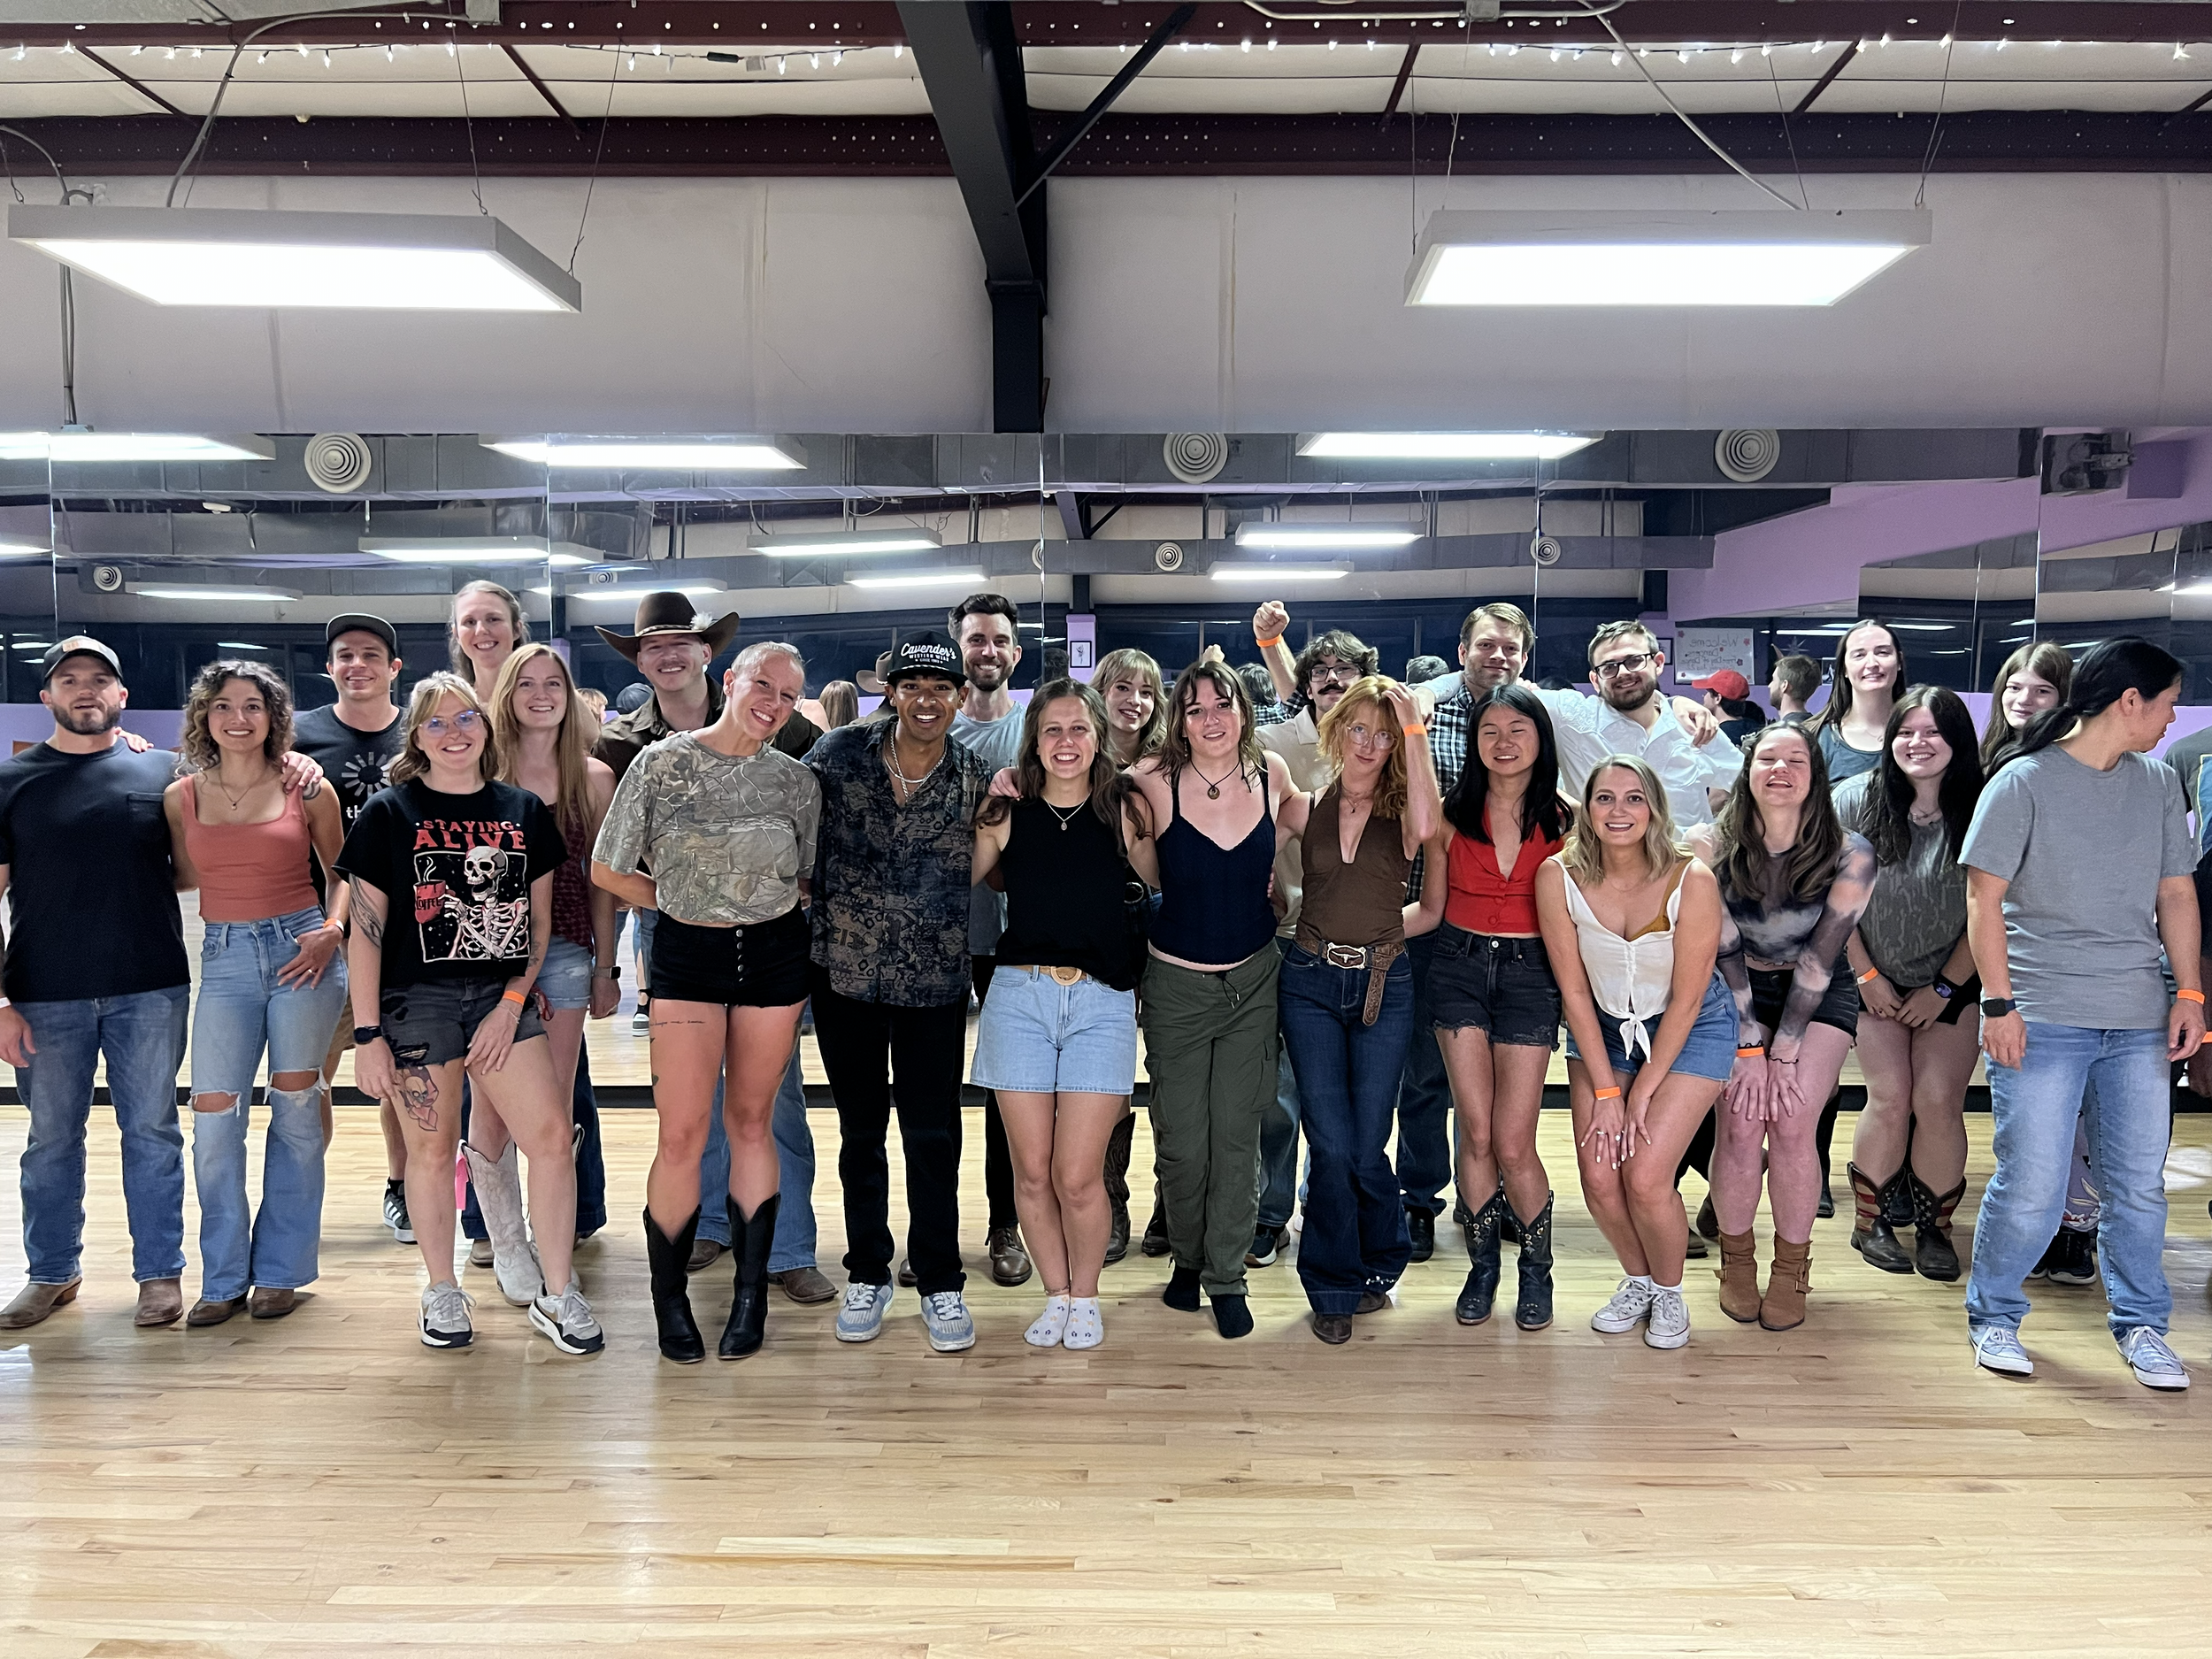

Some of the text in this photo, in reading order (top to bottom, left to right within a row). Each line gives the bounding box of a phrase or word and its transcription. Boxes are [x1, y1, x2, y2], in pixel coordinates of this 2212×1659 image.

[901, 642, 956, 660] Cavender's
[423, 818, 514, 833] STAYING
[413, 829, 526, 850] ALIVE
